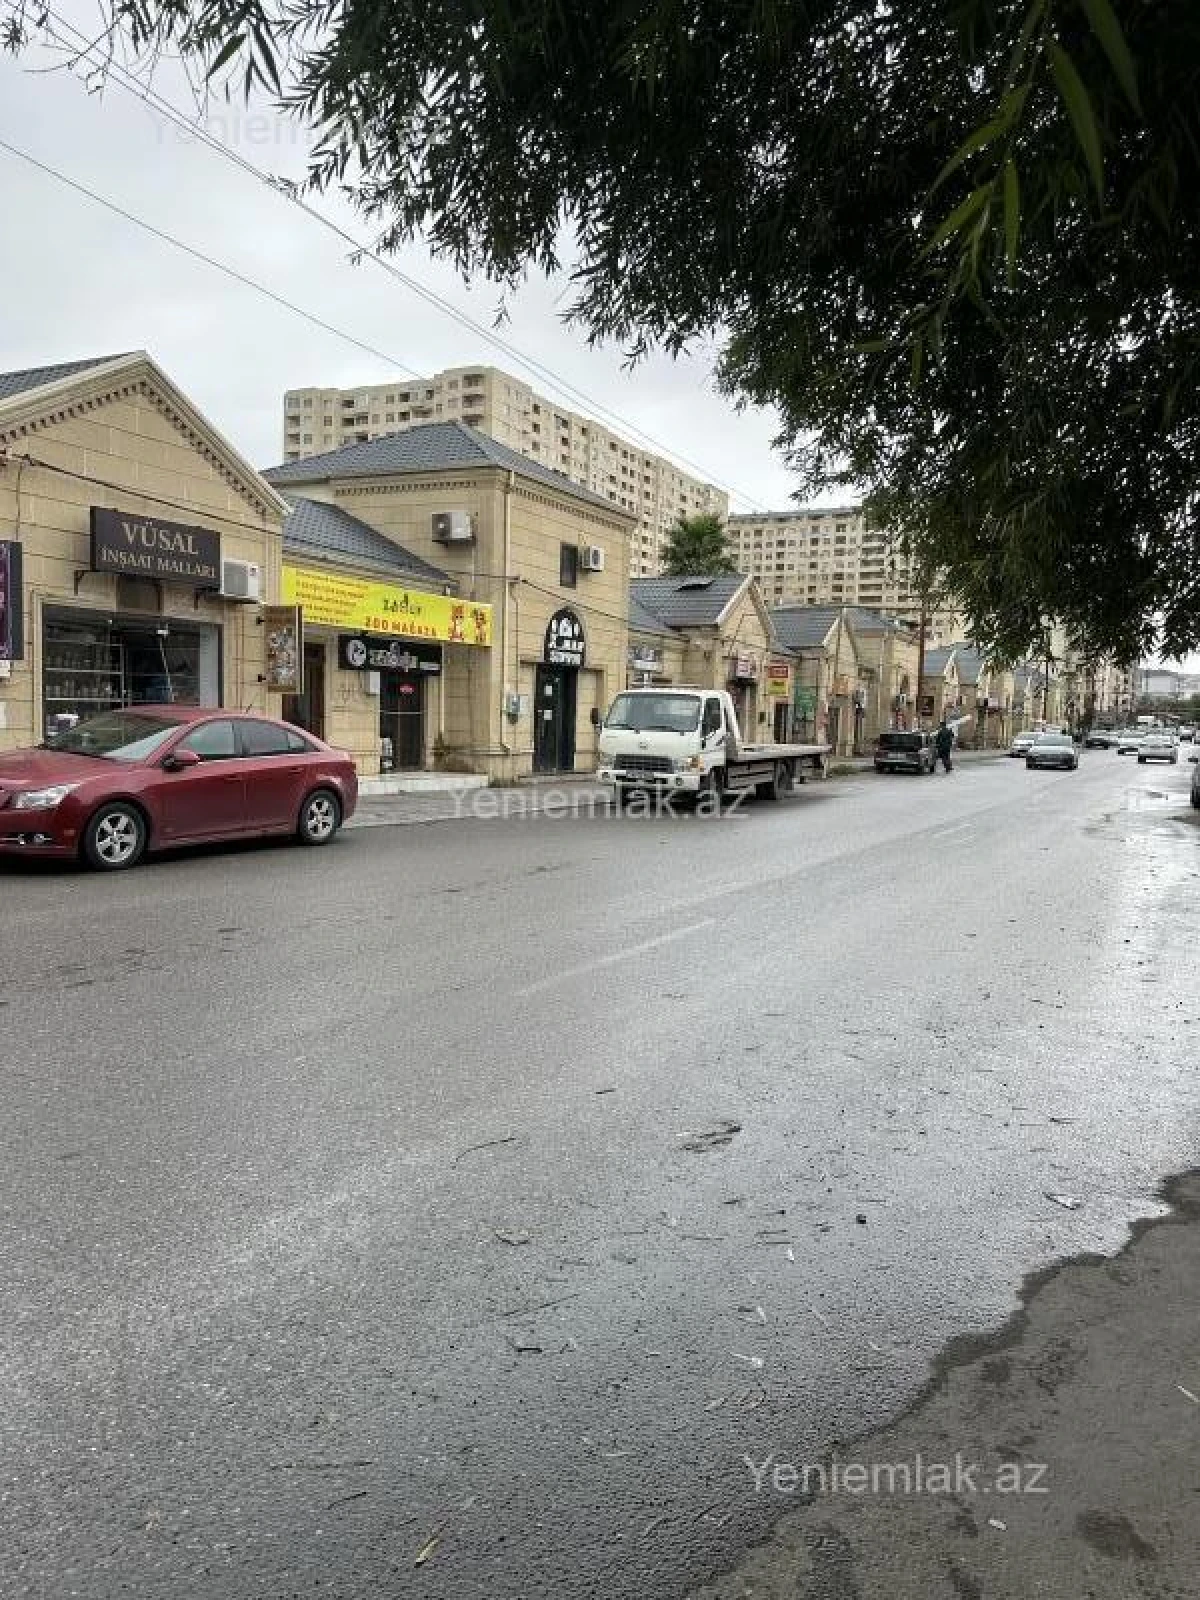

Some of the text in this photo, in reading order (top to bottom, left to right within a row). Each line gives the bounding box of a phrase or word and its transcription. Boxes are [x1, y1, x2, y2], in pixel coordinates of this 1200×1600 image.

[121, 521, 199, 555] VÜSAL
[101, 546, 215, 579] İNŞAAT MALLARI
